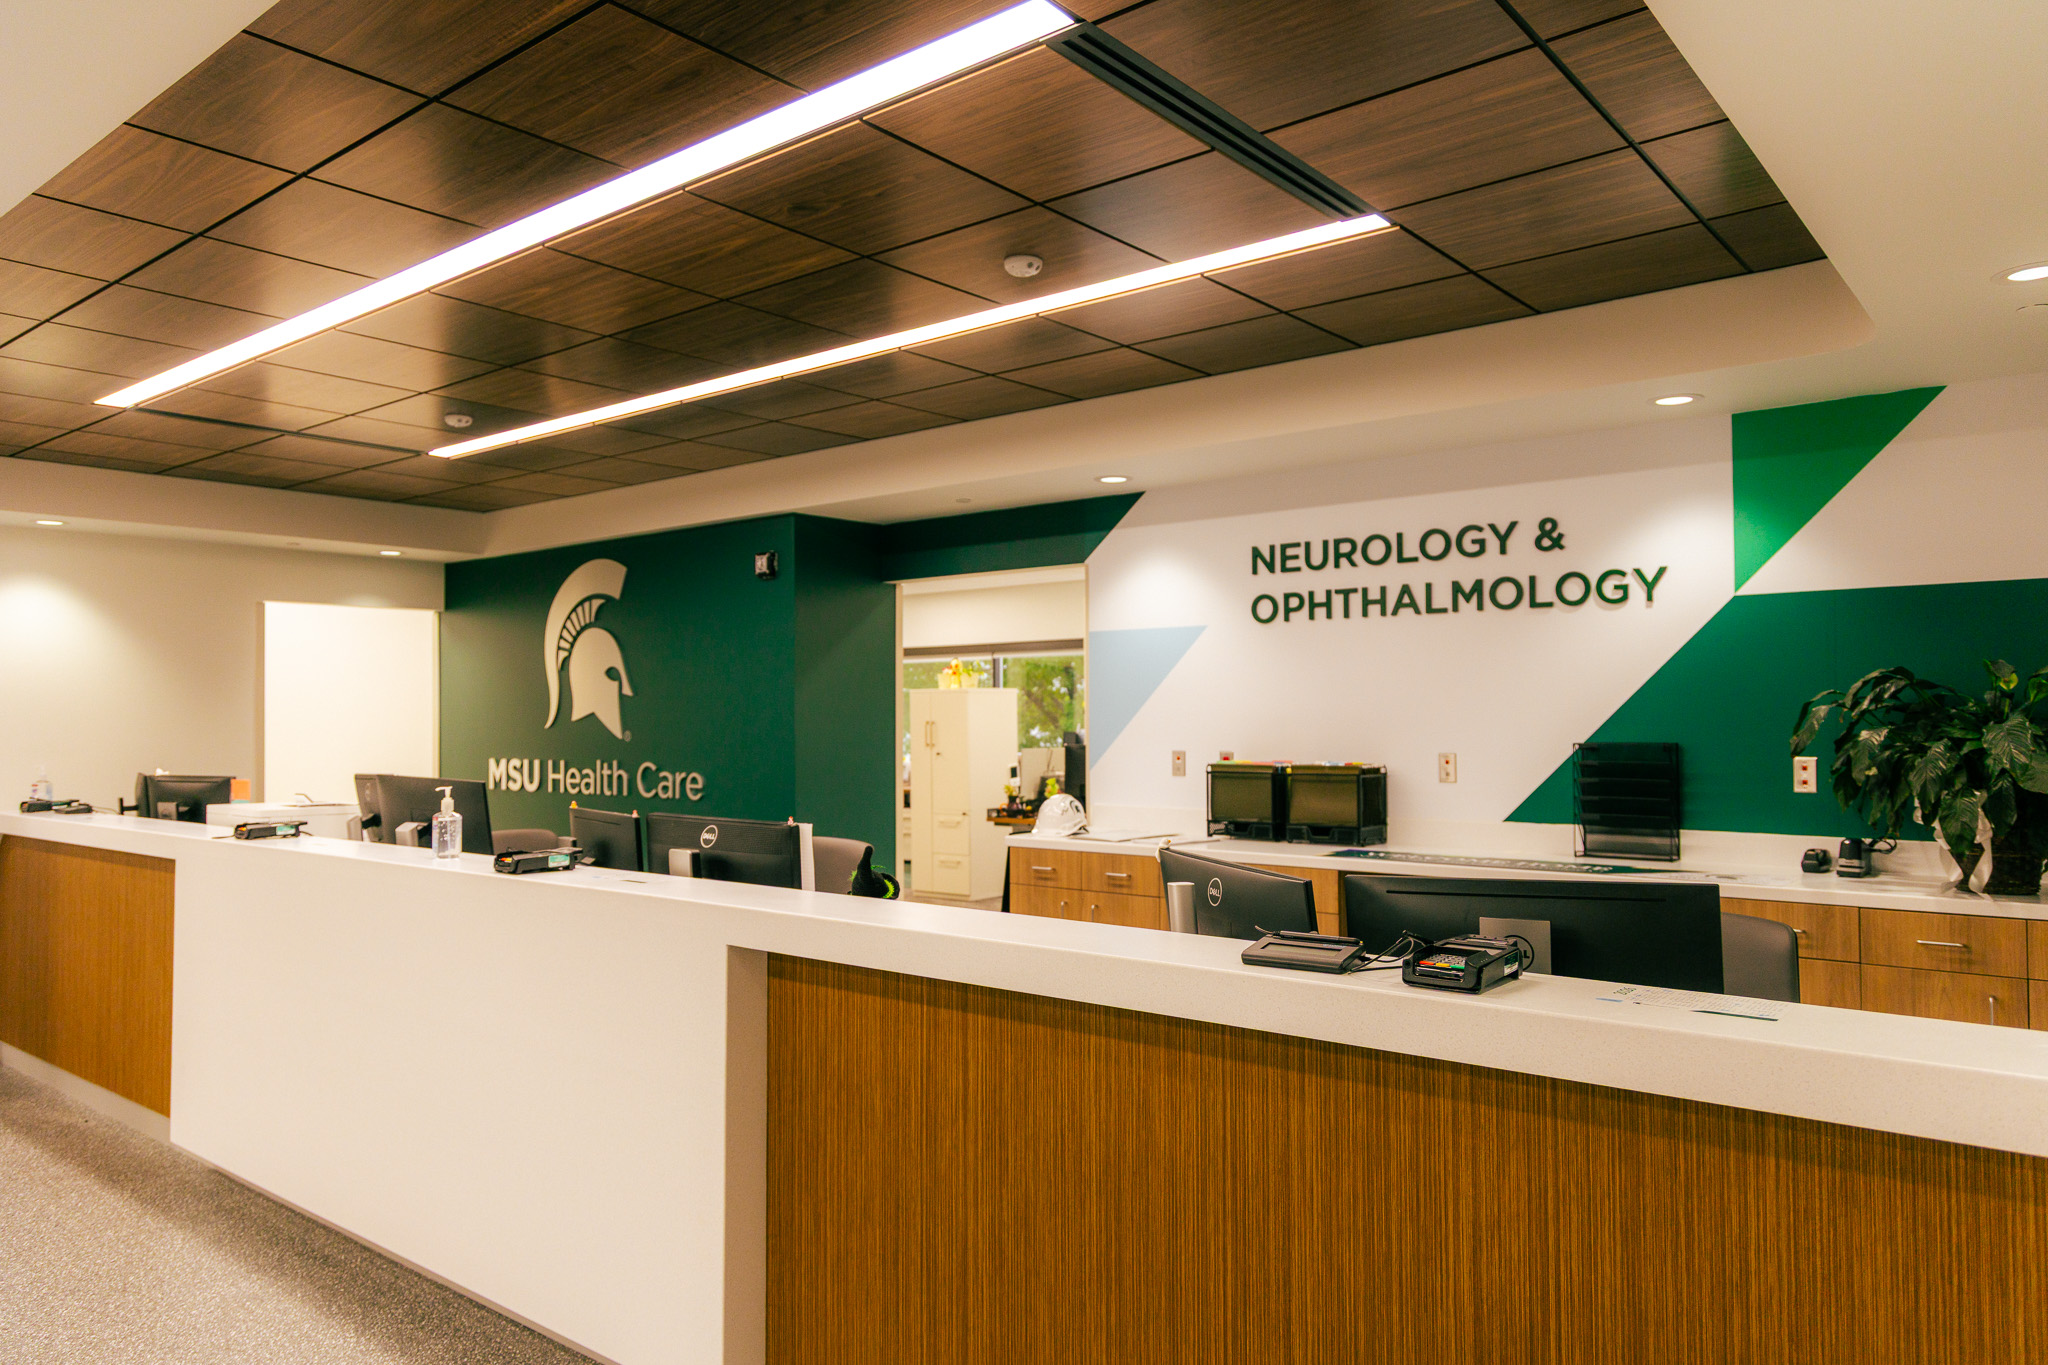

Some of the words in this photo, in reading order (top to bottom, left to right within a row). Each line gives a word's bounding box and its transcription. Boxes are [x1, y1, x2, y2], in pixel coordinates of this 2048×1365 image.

[1251, 520, 1519, 575] NEUROLOGY
[1534, 517, 1566, 552] &
[1251, 566, 1668, 624] OPHTHALMOLOGY
[488, 757, 541, 793] MSU
[547, 759, 629, 797] Health
[636, 761, 704, 801] Care
